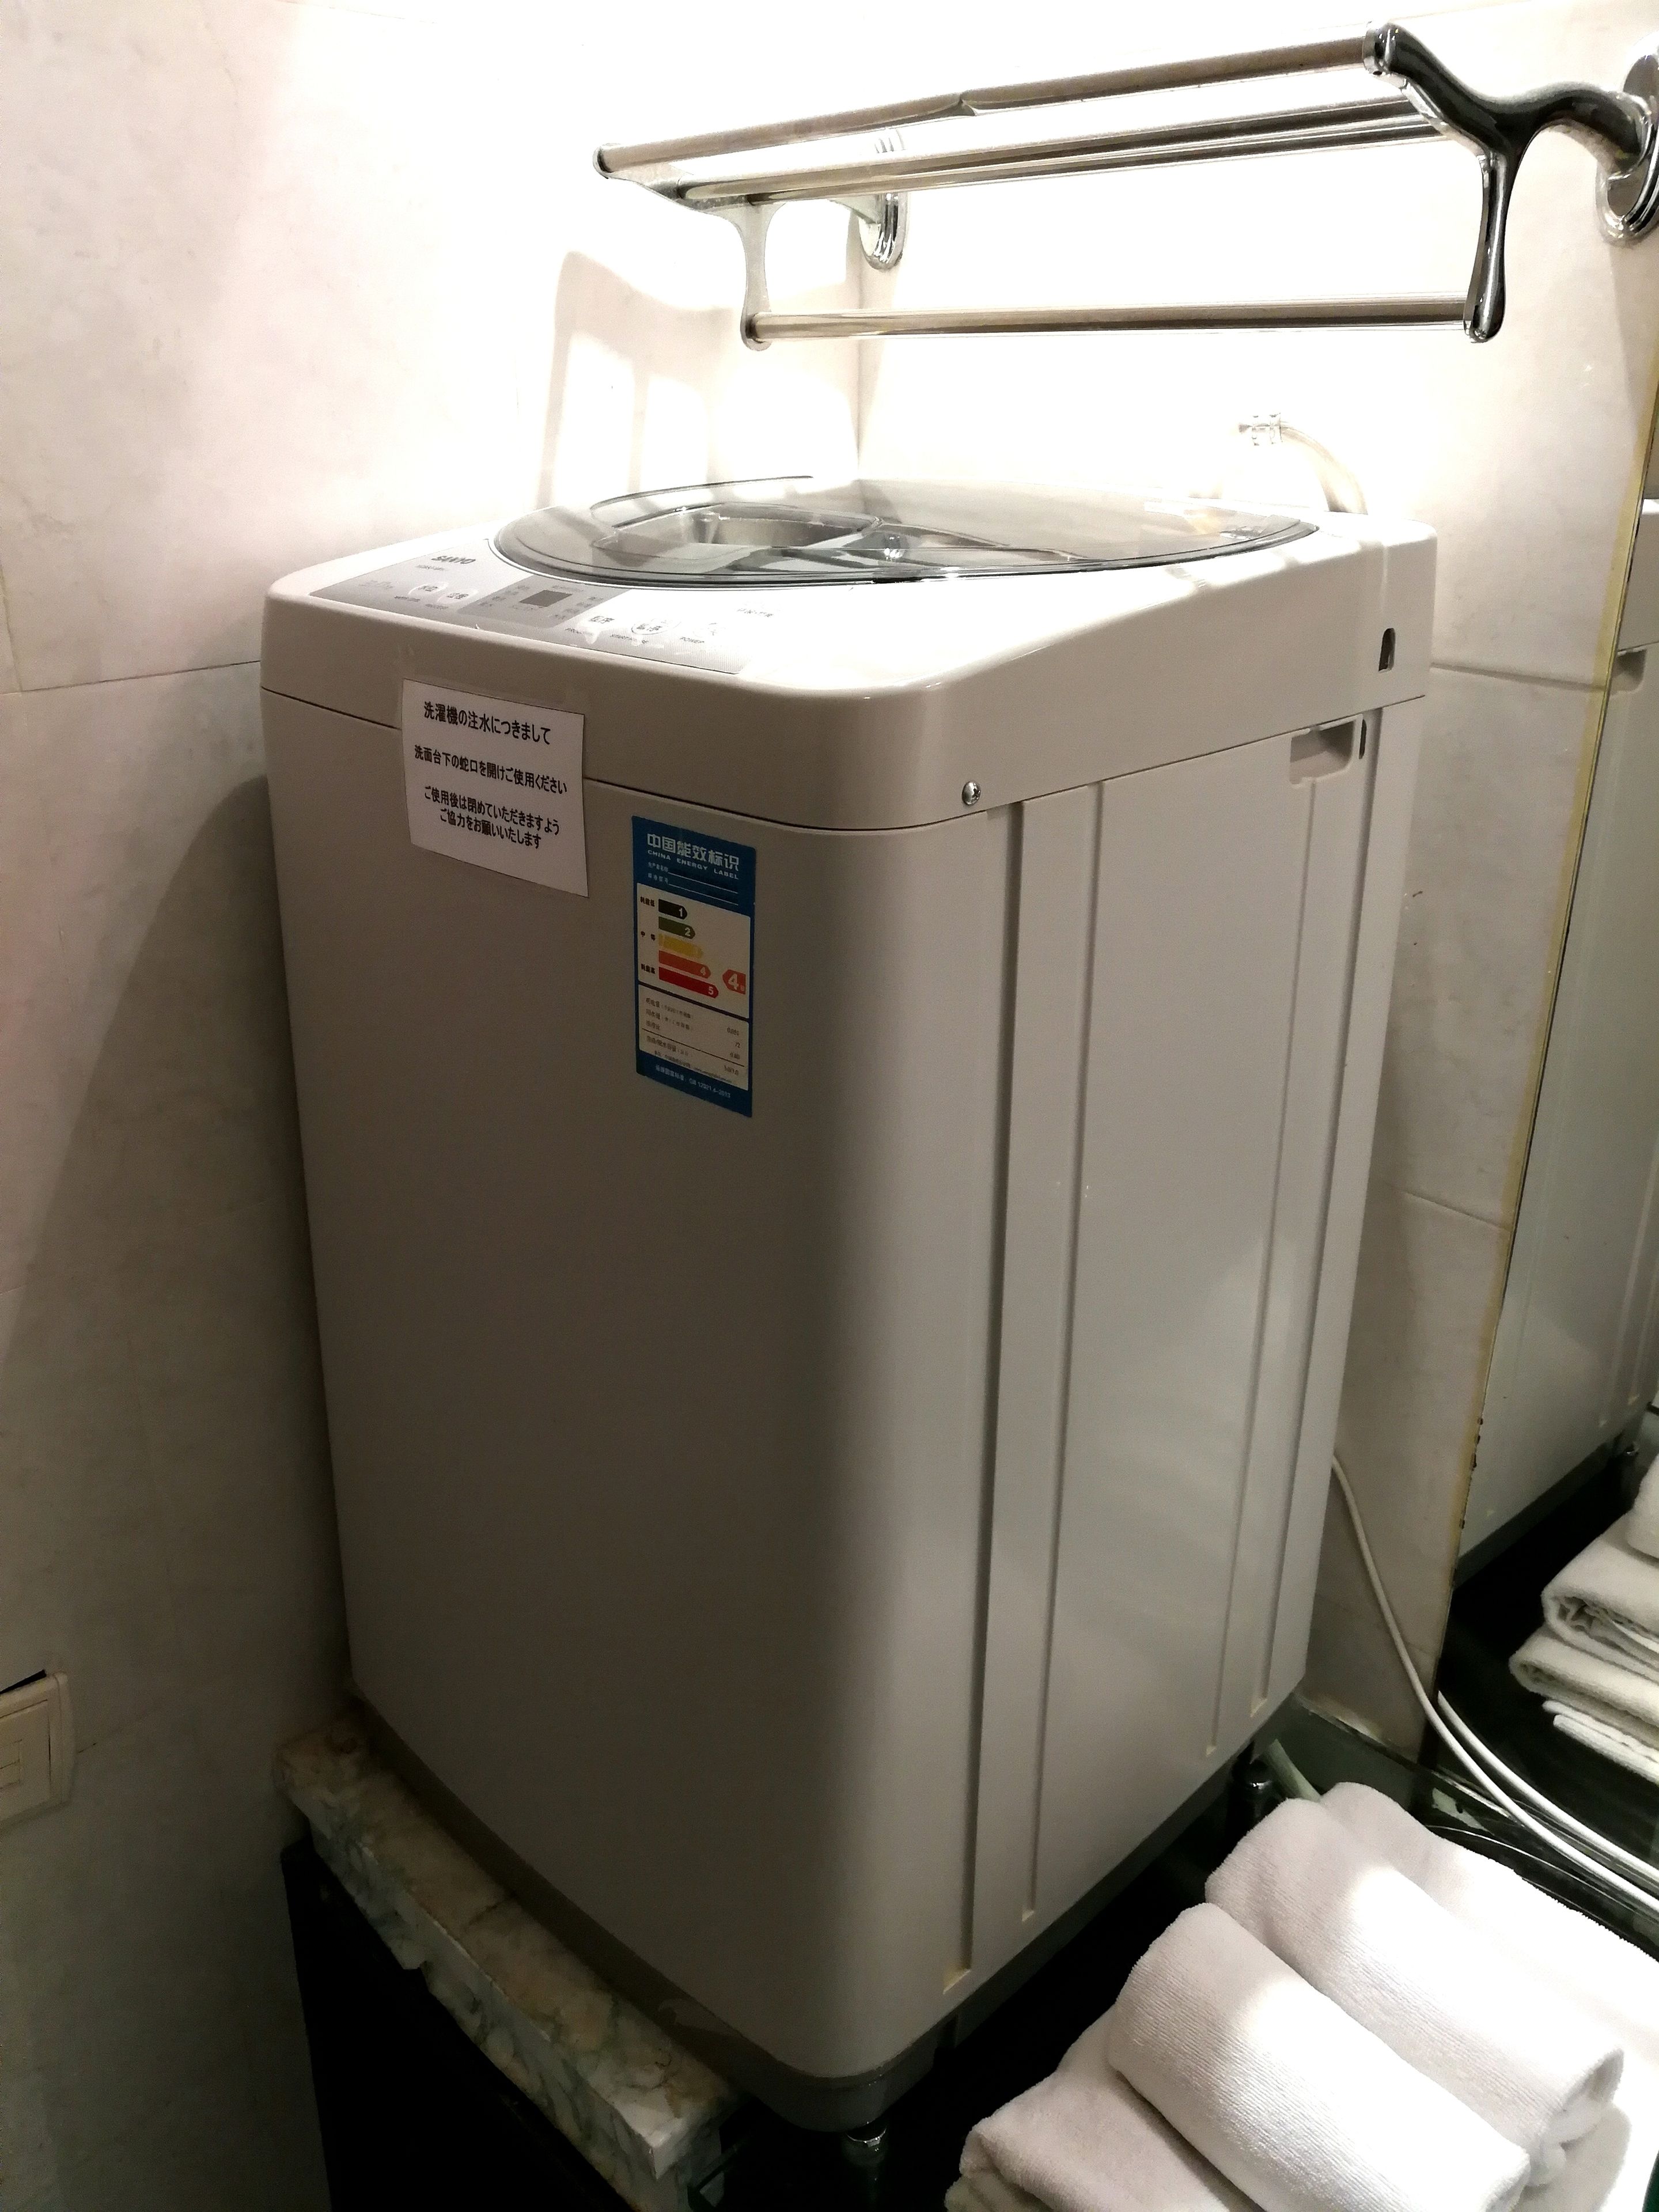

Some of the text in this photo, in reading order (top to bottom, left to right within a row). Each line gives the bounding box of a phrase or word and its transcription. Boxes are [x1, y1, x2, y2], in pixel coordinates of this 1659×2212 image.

[424, 701, 551, 745] 洗濯機の注水につきまして
[414, 745, 567, 794] 洗面台下の蛇口を開けご使用ください
[425, 786, 560, 836] ご使用後は閉めていただきますよう
[440, 809, 541, 849] ご協力をお願いいたします
[647, 833, 740, 872] 中国能效标识
[647, 849, 671, 861] CHINA
[676, 858, 709, 871] ENERGY
[714, 868, 739, 880] LABEL
[678, 907, 684, 918] 1
[684, 926, 692, 937] 2
[700, 967, 706, 976] 4
[728, 973, 739, 991] 4
[708, 986, 714, 995] 5
